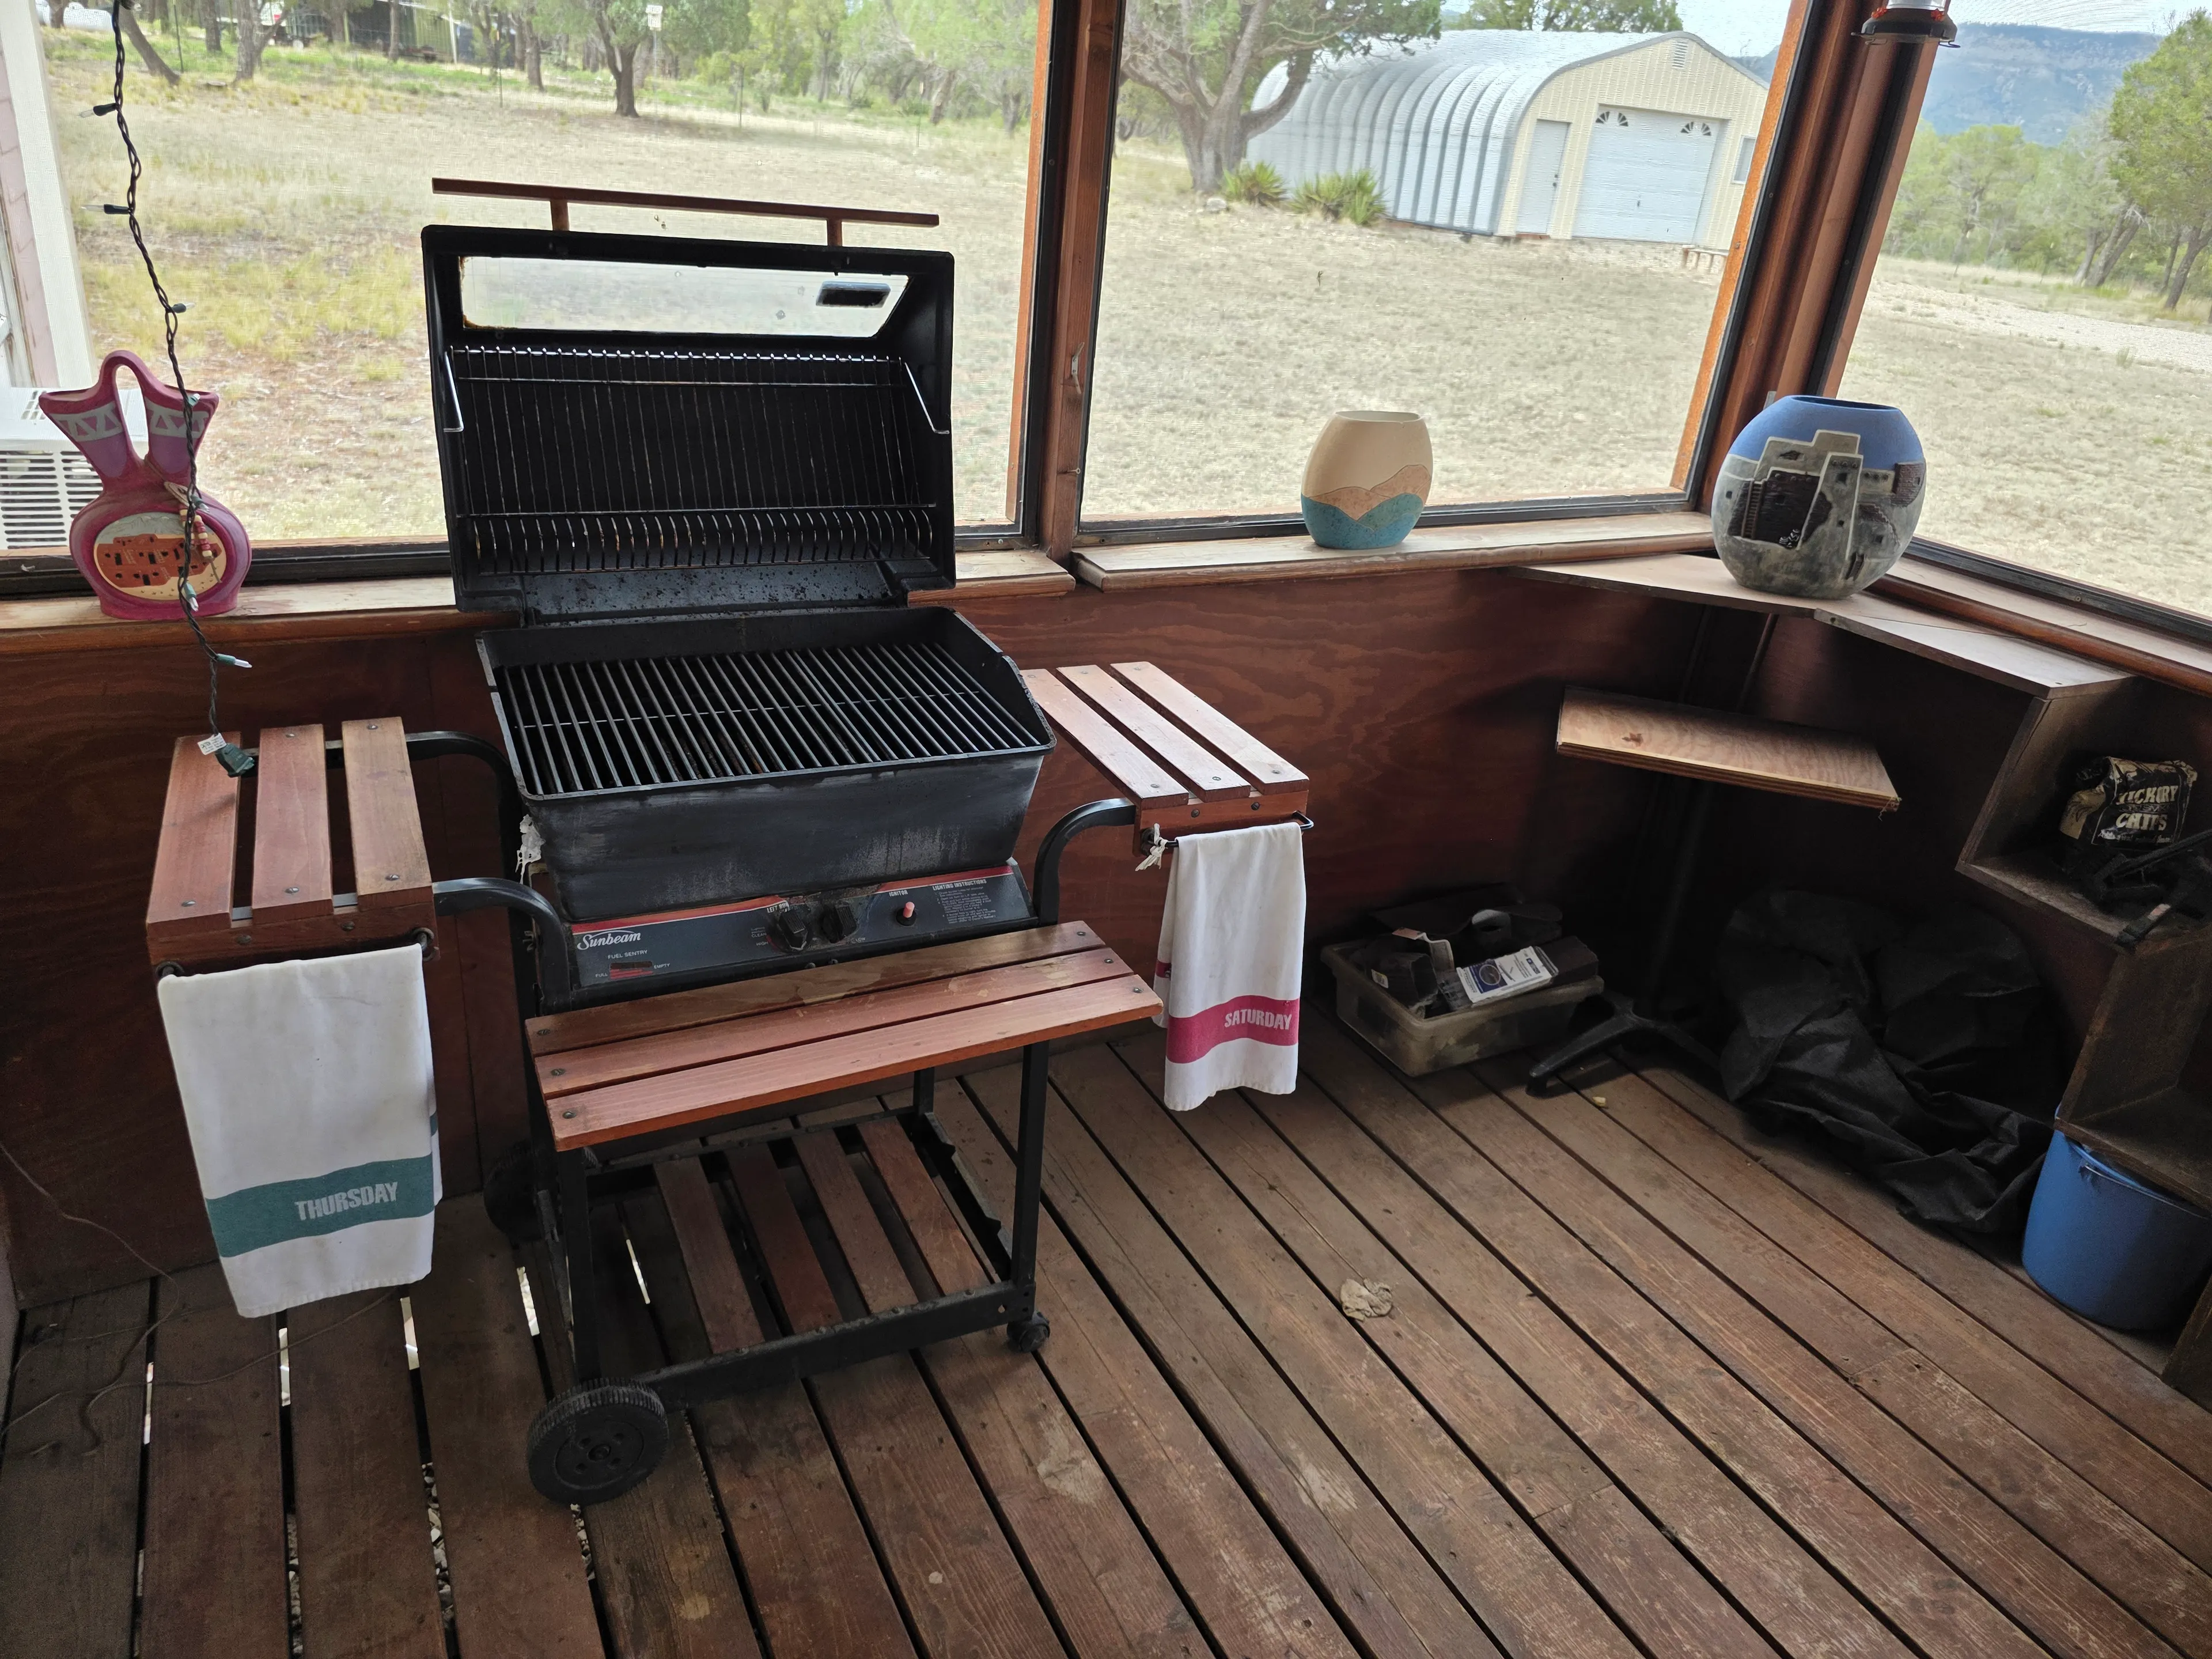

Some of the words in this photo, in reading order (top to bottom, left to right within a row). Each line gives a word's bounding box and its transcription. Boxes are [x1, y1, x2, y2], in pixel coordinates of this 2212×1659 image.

[955, 879, 987, 888] INSTRUCTIONS
[577, 931, 641, 950] Sunbeam
[1224, 1009, 1292, 1030] SATURDAY
[294, 1181, 398, 1221] THURSDAY
